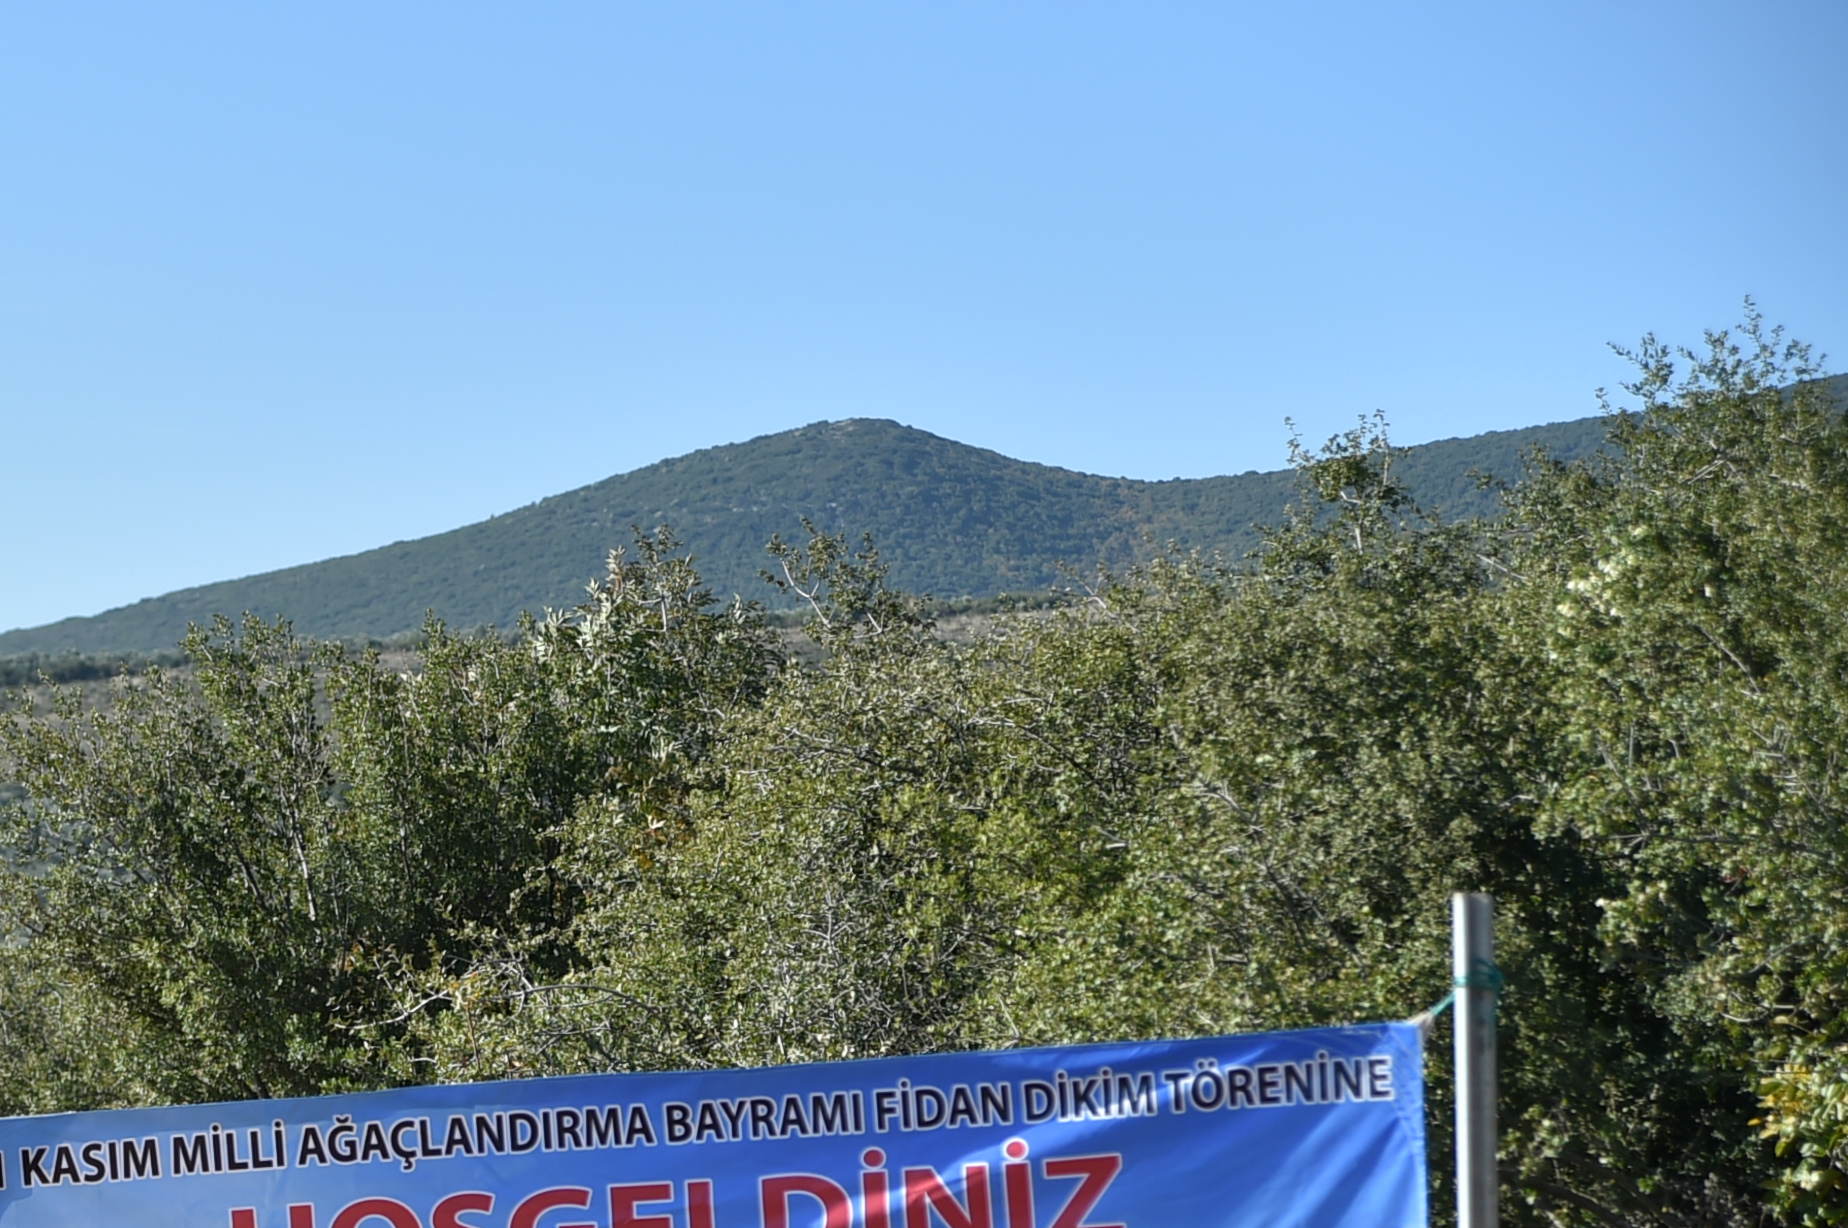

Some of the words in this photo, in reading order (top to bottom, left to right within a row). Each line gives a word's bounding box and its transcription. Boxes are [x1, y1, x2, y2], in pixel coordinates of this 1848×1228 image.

[22, 1138, 161, 1187] KASIM
[172, 1121, 286, 1176] MİLLİ
[297, 1102, 654, 1171] AĞAÇLANDIRMA
[666, 1091, 861, 1144] BAYRAMI
[875, 1078, 1013, 1132] FİDAN
[1025, 1070, 1156, 1123] DİKİM
[1165, 1050, 1395, 1114] TÖRENİNE
